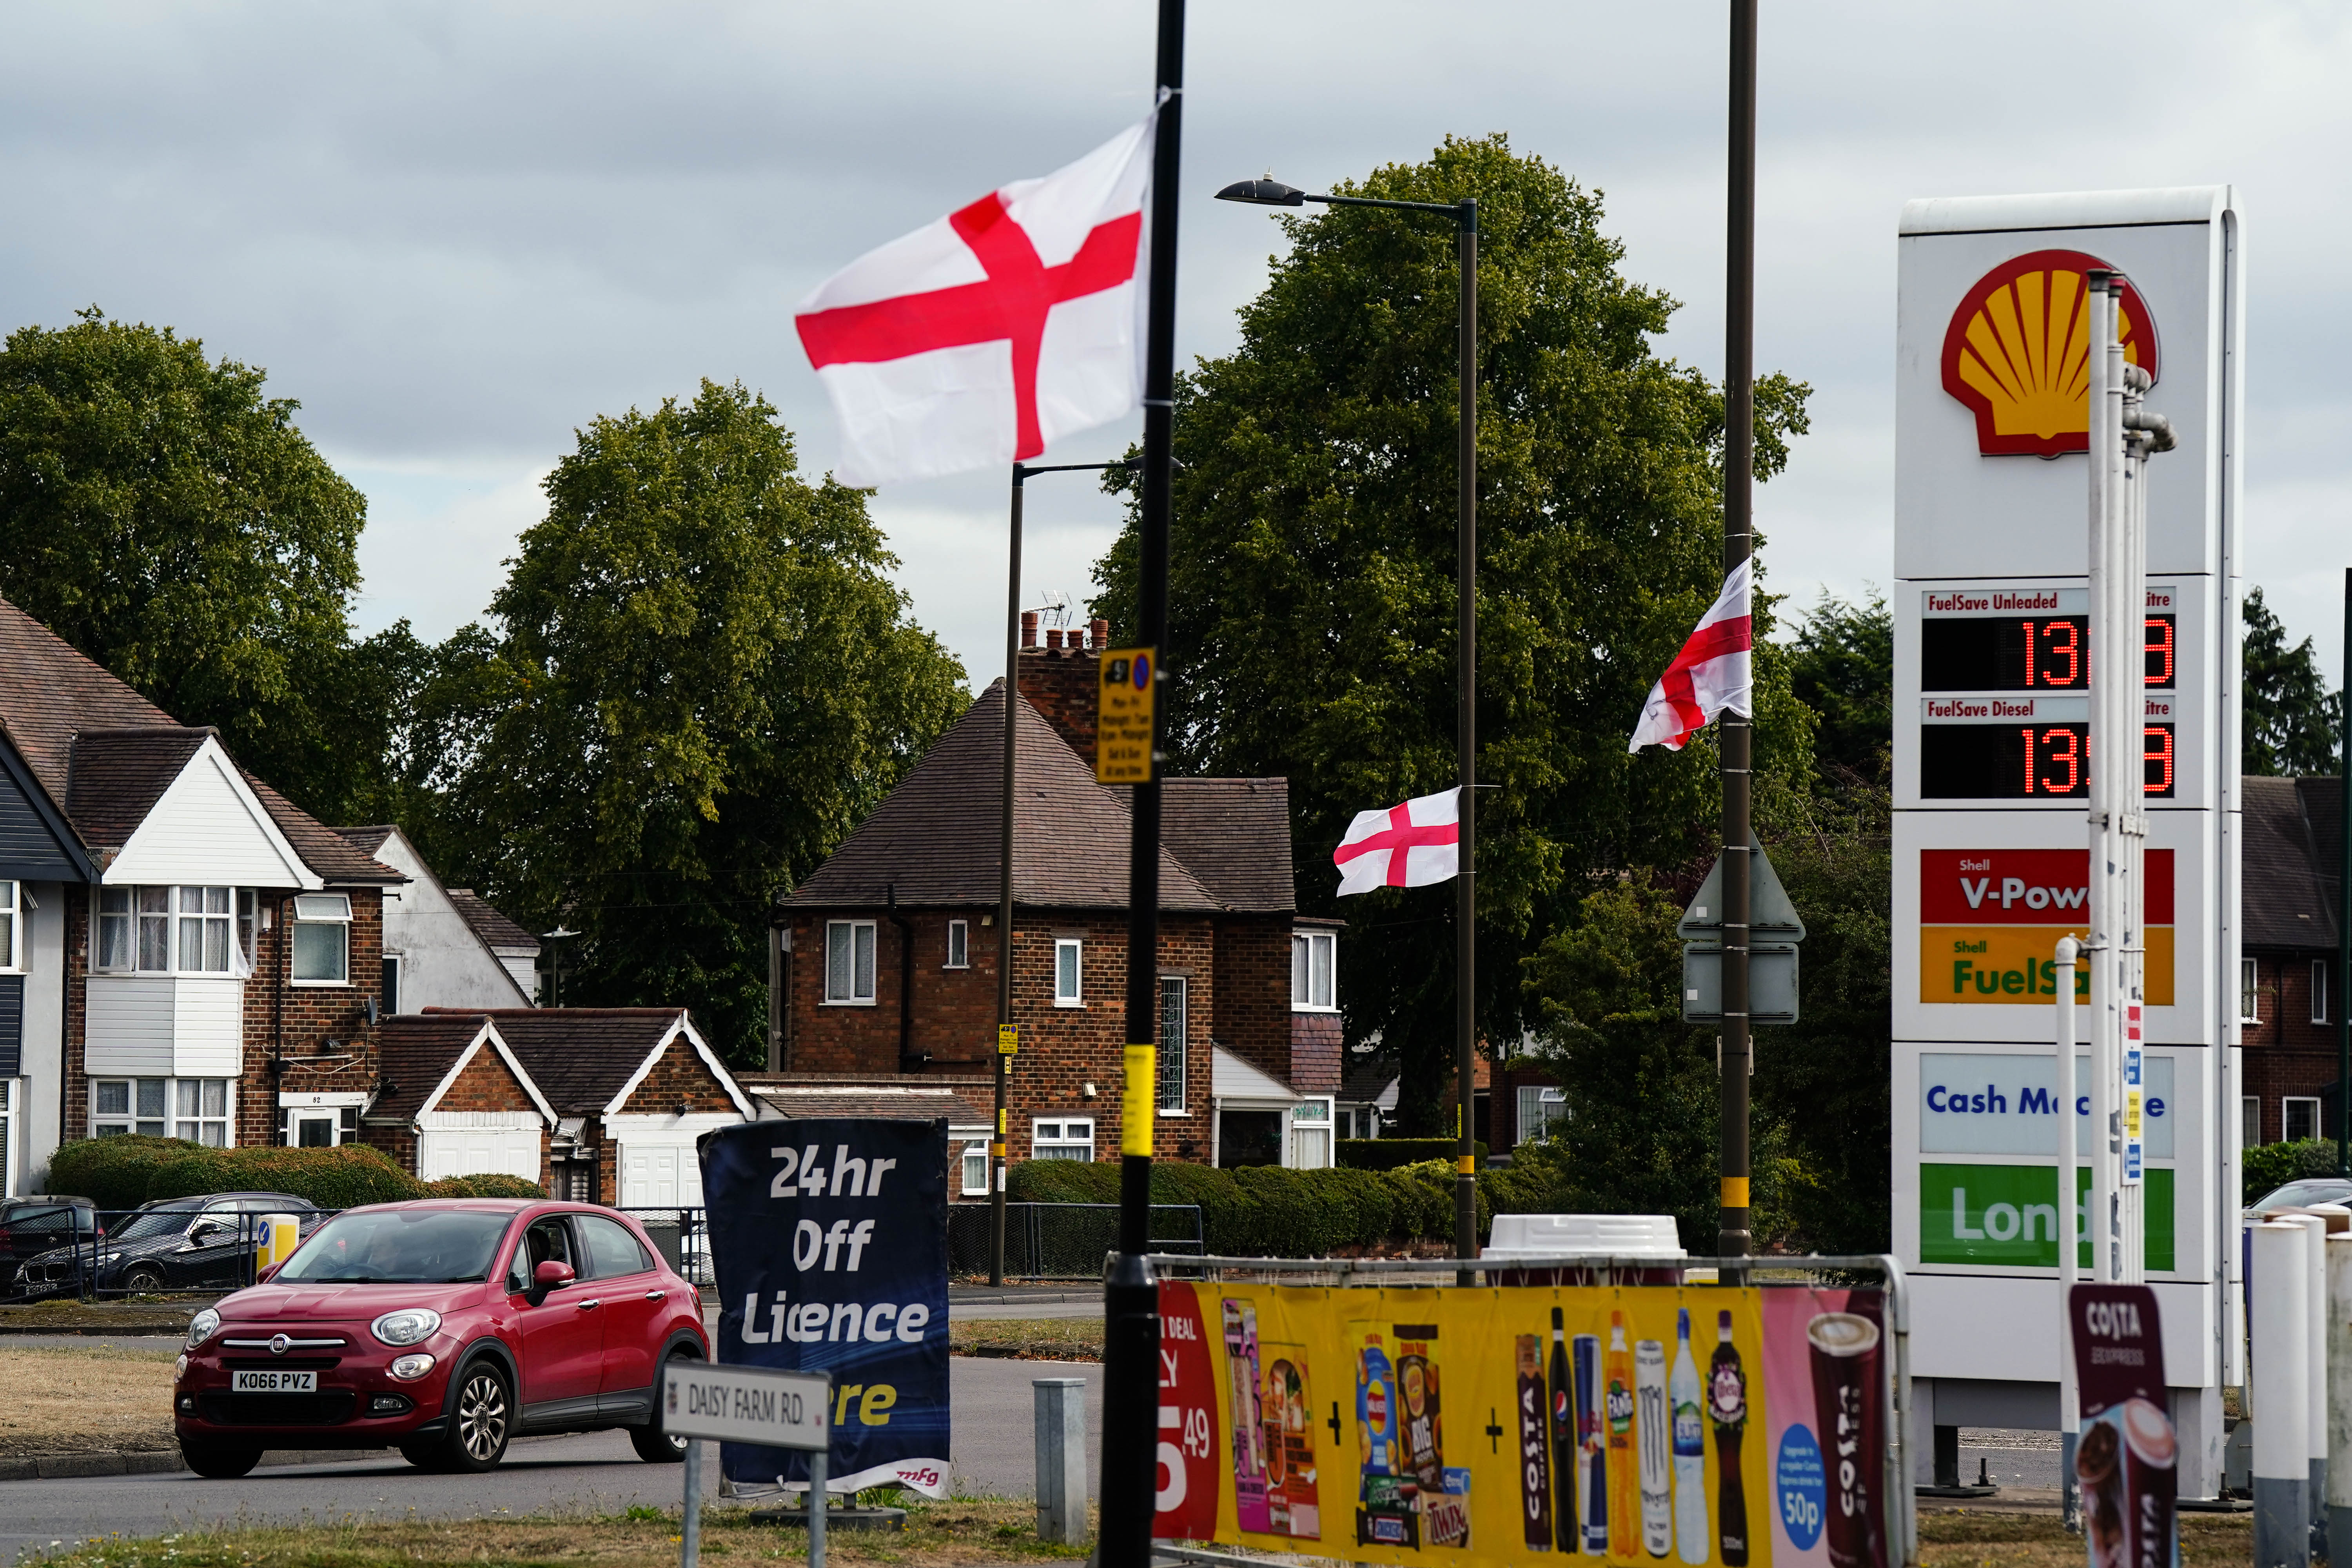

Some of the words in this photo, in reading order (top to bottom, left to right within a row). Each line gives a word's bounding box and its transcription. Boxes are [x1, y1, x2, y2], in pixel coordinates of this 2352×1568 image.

[1929, 594, 1988, 611] FuelSave
[1993, 592, 2057, 610] Unleaded
[2145, 592, 2170, 606] itre
[1928, 700, 1987, 717] FuelSave
[1993, 700, 2034, 717] Diesel
[2145, 700, 2169, 715] itre
[1960, 859, 1990, 871] Shell
[1960, 877, 2090, 909] V-Pow
[1954, 940, 1986, 953] Shell
[1927, 1084, 2007, 1114] Cash
[770, 1144, 897, 1198] 24hr
[793, 1219, 875, 1272] Off
[742, 1290, 929, 1344] Licence
[1168, 1316, 1197, 1340] DEAL
[2086, 1301, 2143, 1341] COSTA
[274, 1340, 284, 1349] FIAT
[281, 1374, 311, 1389] PVZ
[689, 1383, 730, 1418] DAISY
[734, 1387, 776, 1423] FARM
[829, 1384, 897, 1426] re
[1523, 1387, 1540, 1521] COSTA
[897, 1468, 939, 1486] mfg
[1785, 1491, 1819, 1535] 50p
